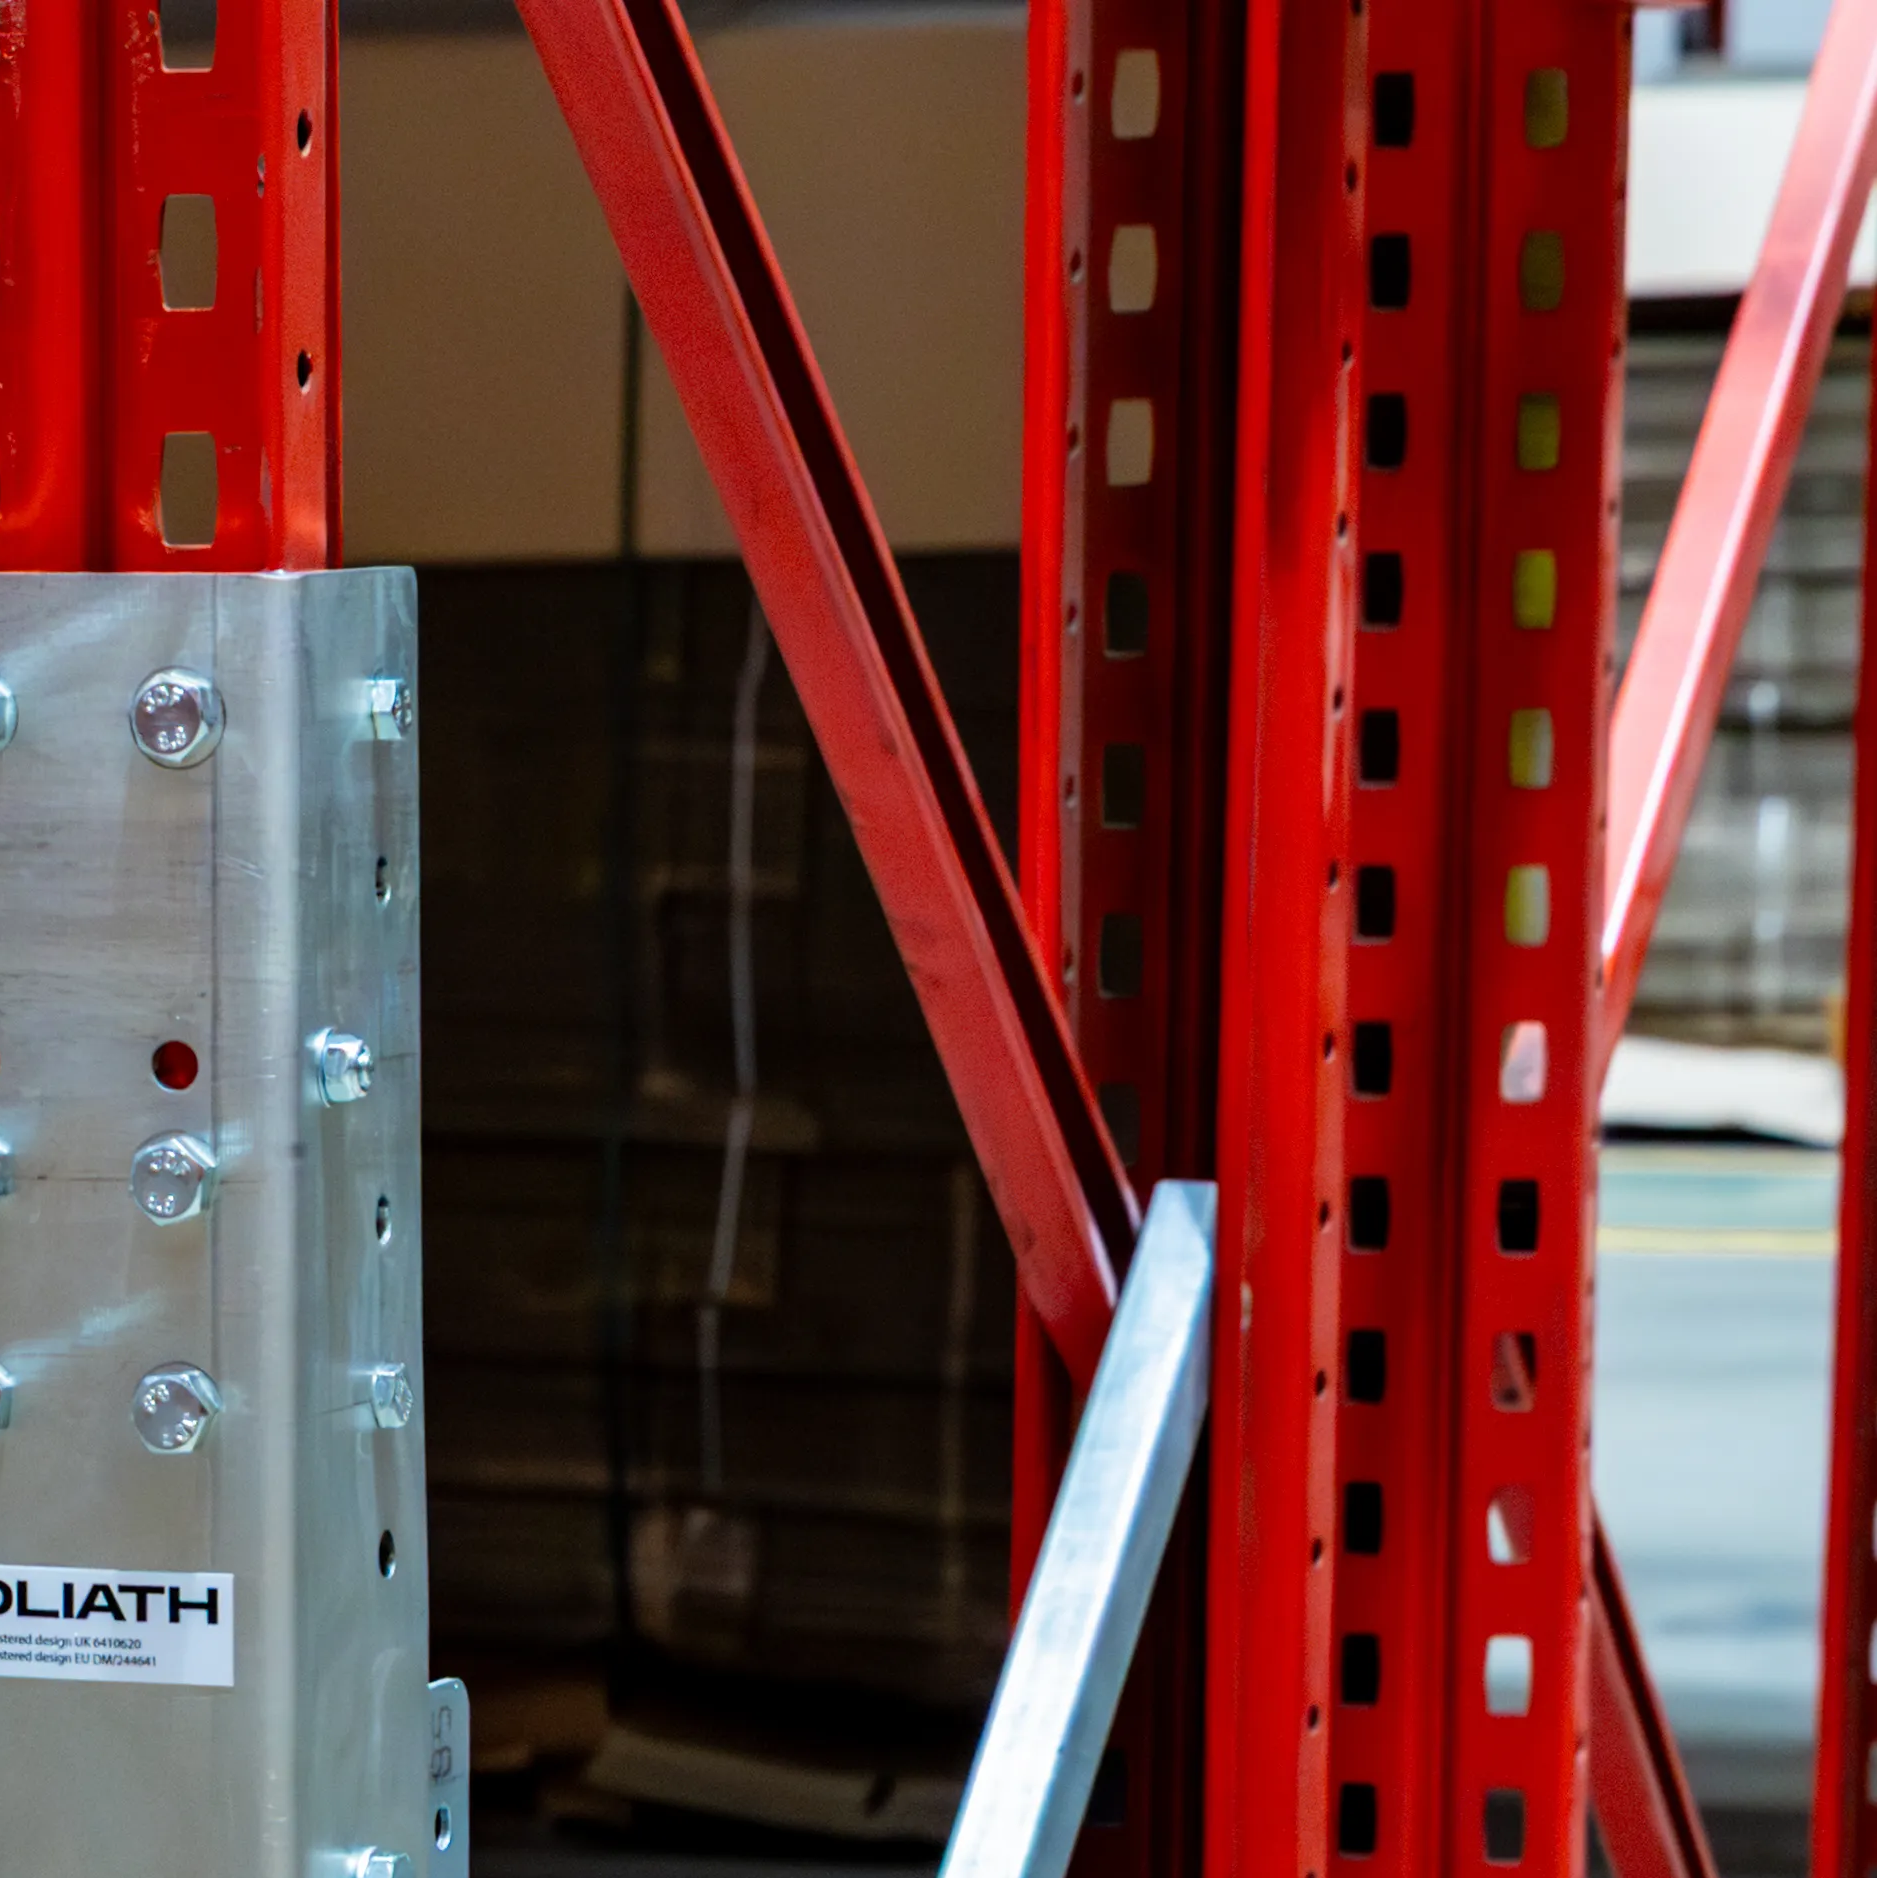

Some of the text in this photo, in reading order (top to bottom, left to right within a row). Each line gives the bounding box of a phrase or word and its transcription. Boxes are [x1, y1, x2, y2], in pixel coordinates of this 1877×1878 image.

[34, 1634, 72, 1649] design
[74, 1637, 91, 1648] UK
[34, 1651, 72, 1666] design
[74, 1652, 90, 1664] EU
